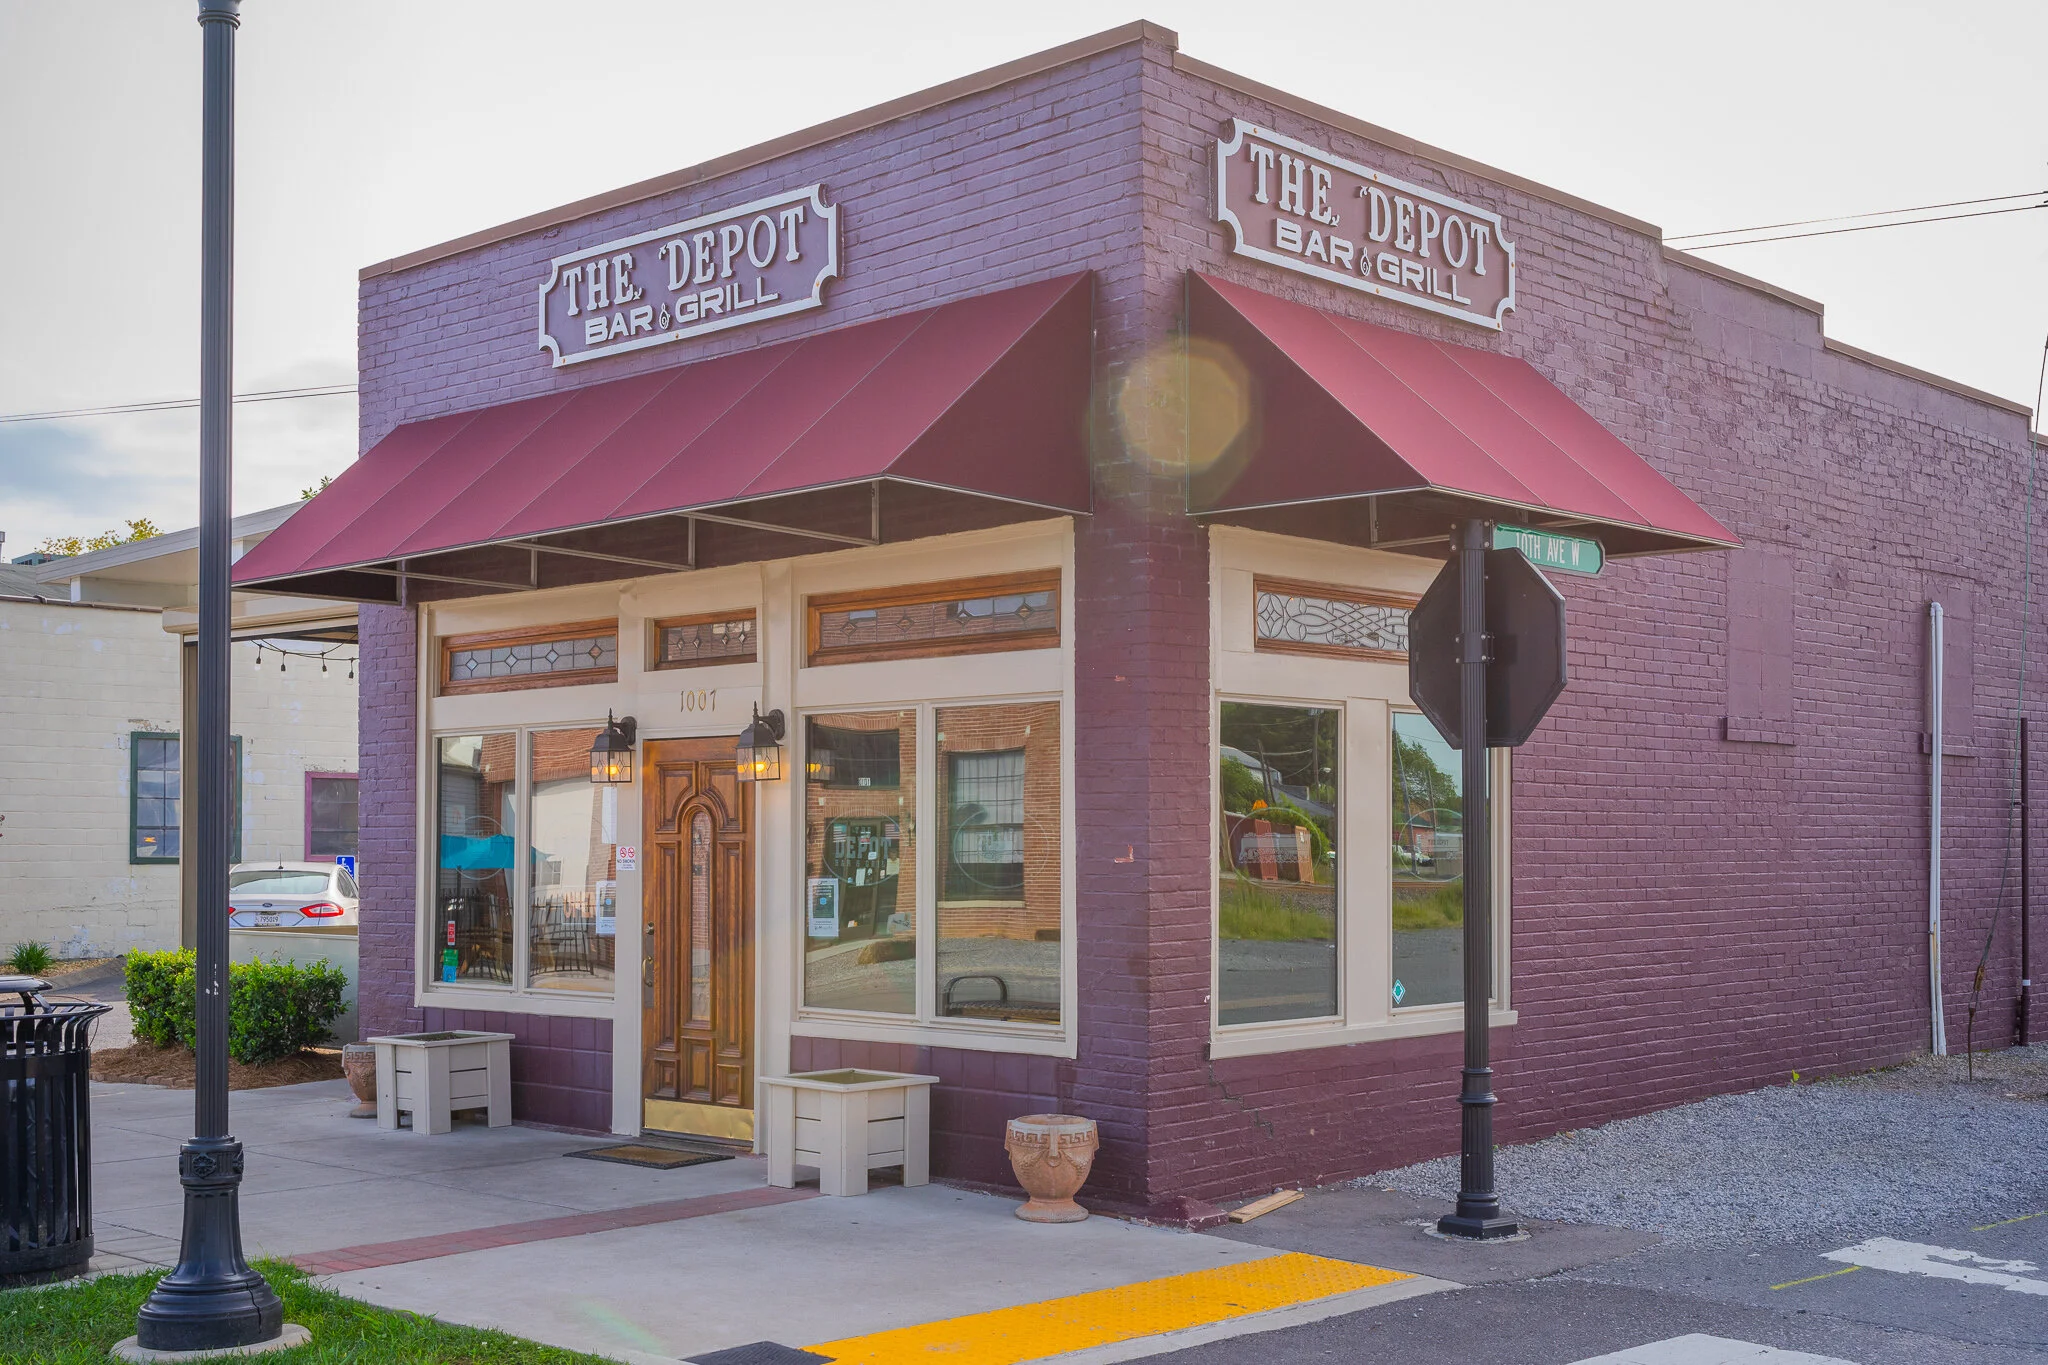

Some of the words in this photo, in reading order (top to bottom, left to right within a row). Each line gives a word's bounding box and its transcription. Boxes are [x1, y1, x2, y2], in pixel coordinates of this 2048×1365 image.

[1249, 142, 1336, 226] THE
[1365, 186, 1490, 277] DEPOT
[562, 252, 638, 317] THE
[663, 204, 805, 292] DEPOT
[1275, 217, 1355, 270] BAR
[1376, 251, 1472, 306] GRILL
[584, 304, 654, 345] BAR
[674, 275, 779, 324] GRILL
[1515, 532, 1541, 560] 10TH
[1546, 537, 1566, 564] AVE
[1571, 541, 1581, 566] W
[680, 688, 717, 712] 1007
[834, 836, 892, 859] DEPOT
